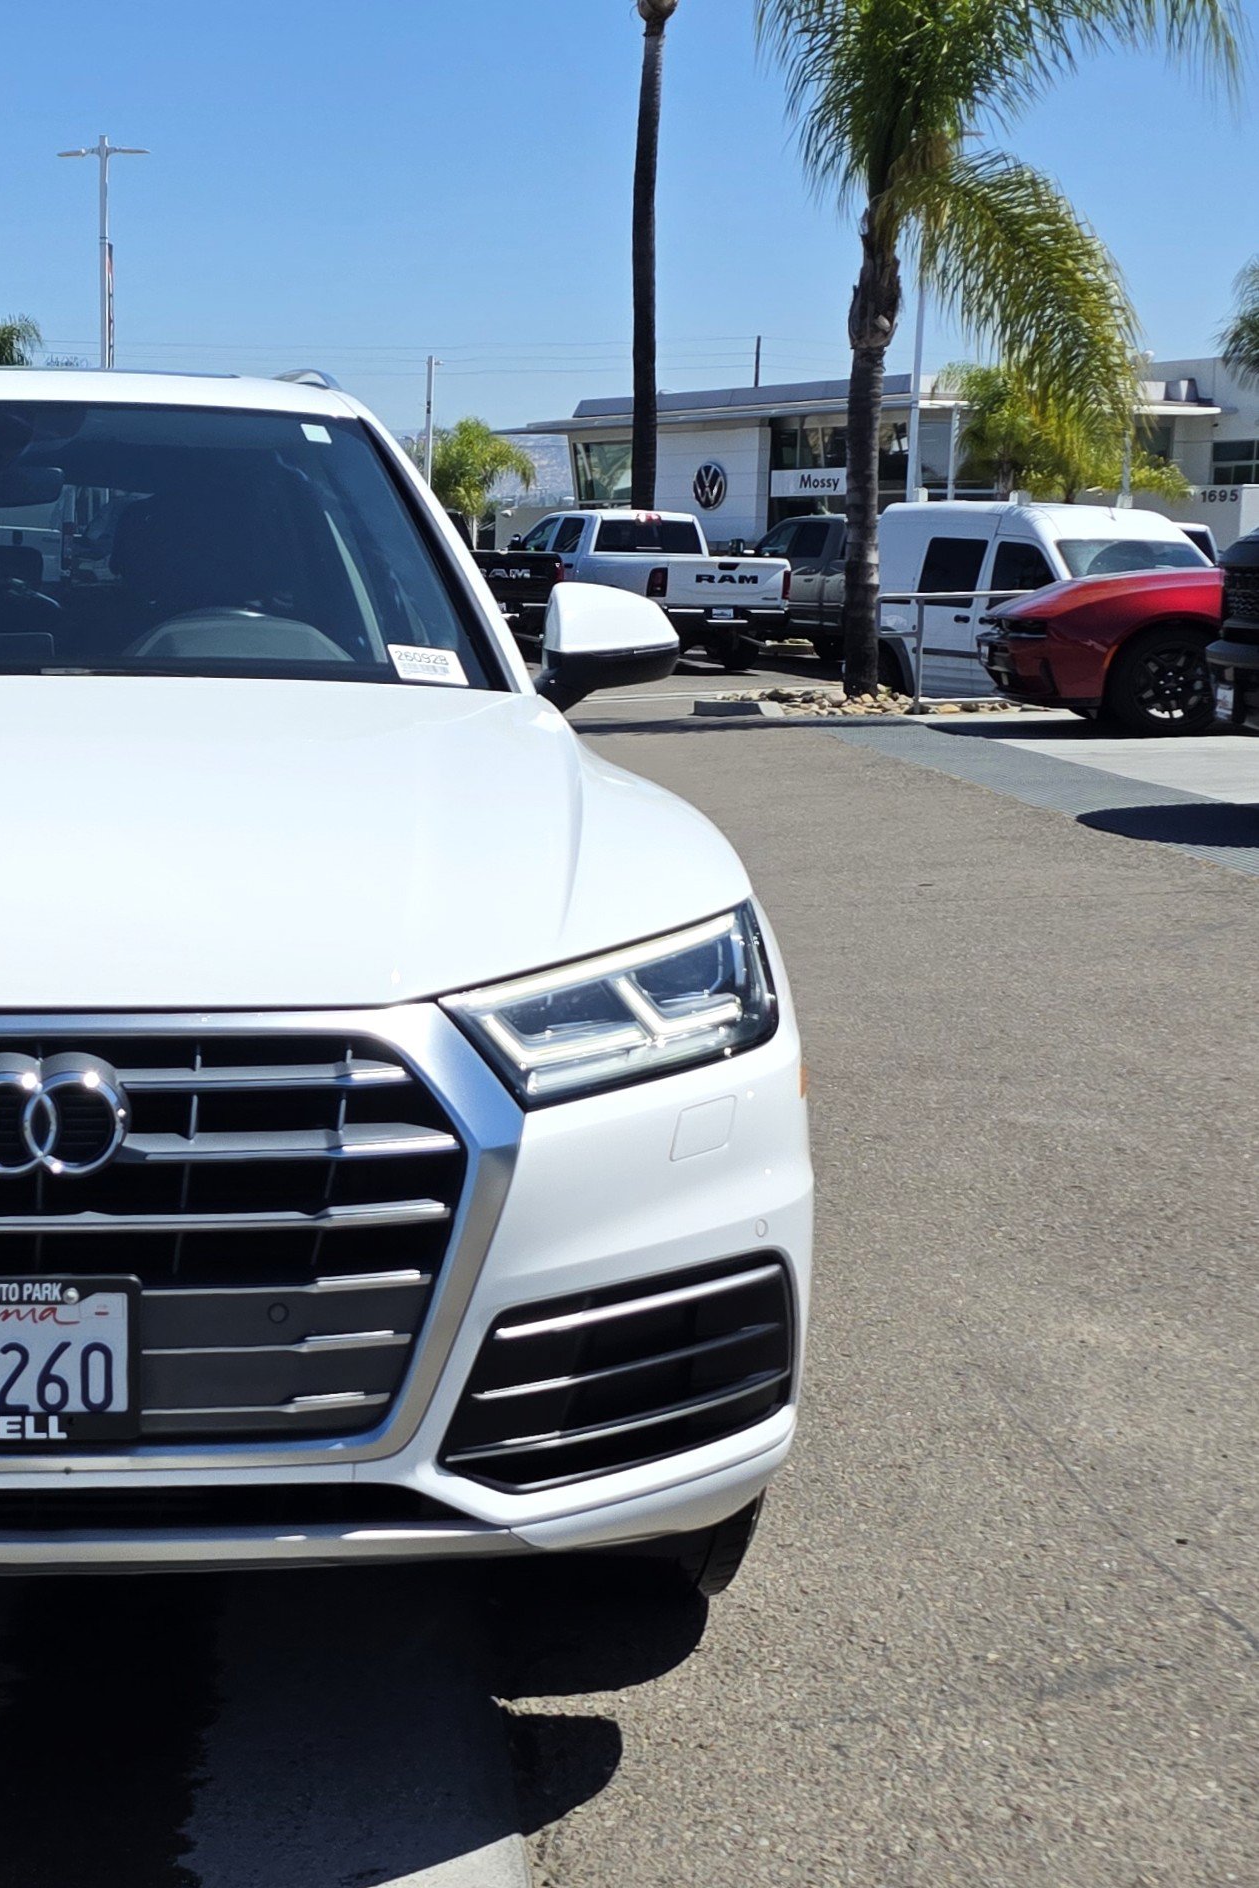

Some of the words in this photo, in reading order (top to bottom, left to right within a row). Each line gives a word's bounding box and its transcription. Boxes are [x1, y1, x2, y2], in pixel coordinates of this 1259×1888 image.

[799, 474, 840, 492] Mossy
[1201, 489, 1239, 503] 1695
[695, 574, 758, 584] RAM
[22, 1282, 62, 1301] PARK
